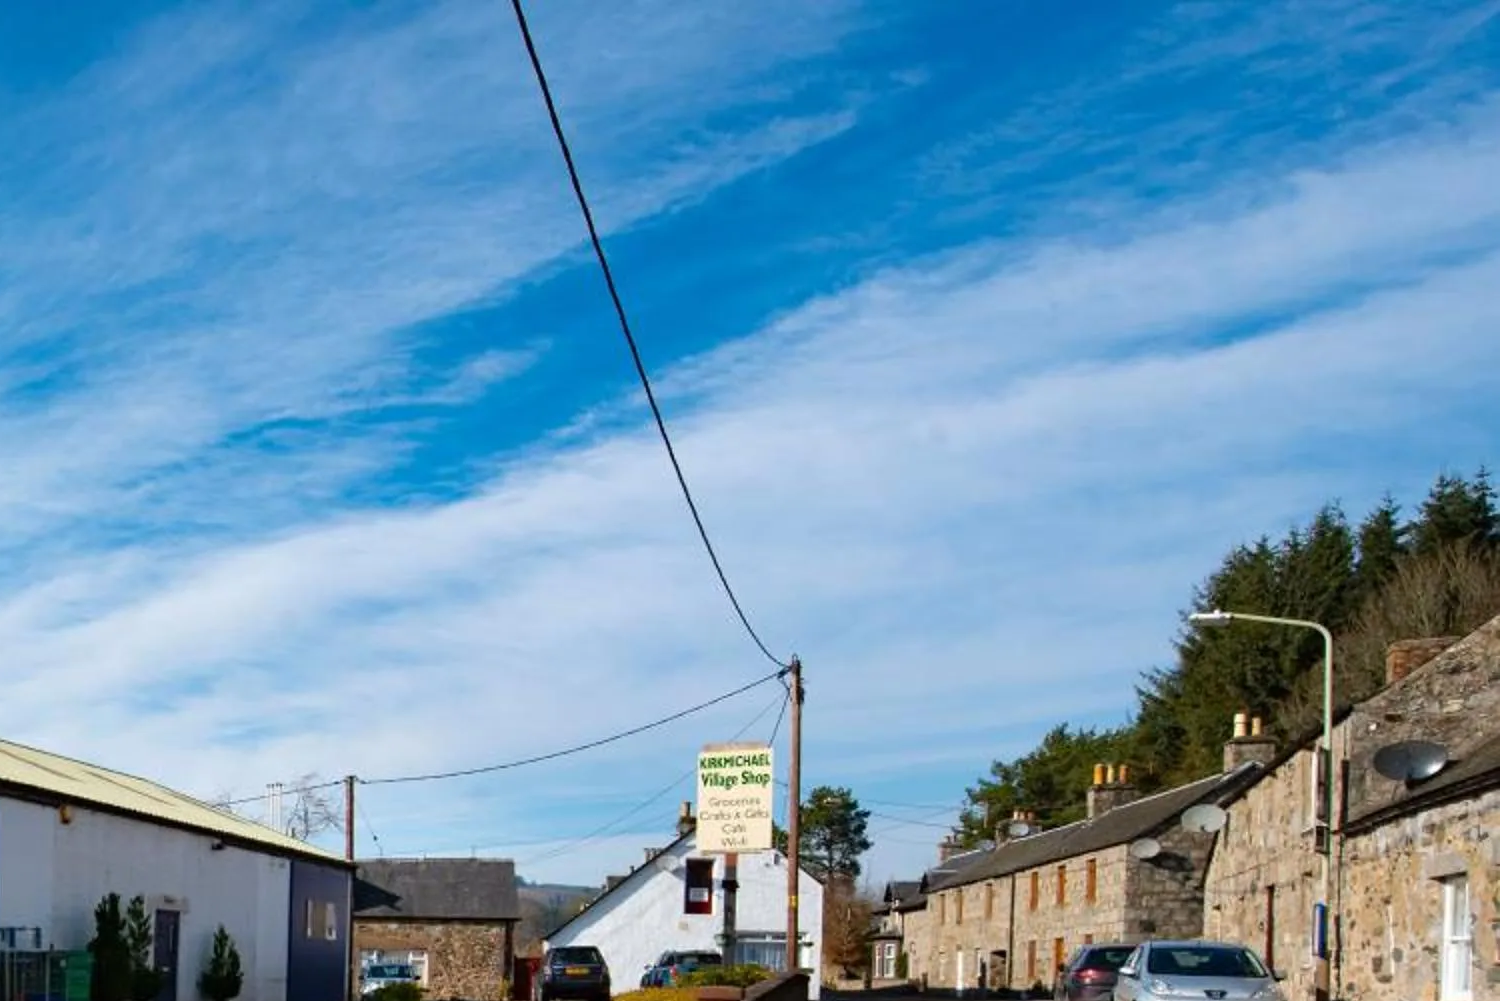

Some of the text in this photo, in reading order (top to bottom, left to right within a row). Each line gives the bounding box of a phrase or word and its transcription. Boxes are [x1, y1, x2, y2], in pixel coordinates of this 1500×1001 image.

[700, 754, 771, 769] KIRKMICHAEL
[701, 771, 771, 790] Village Shop
